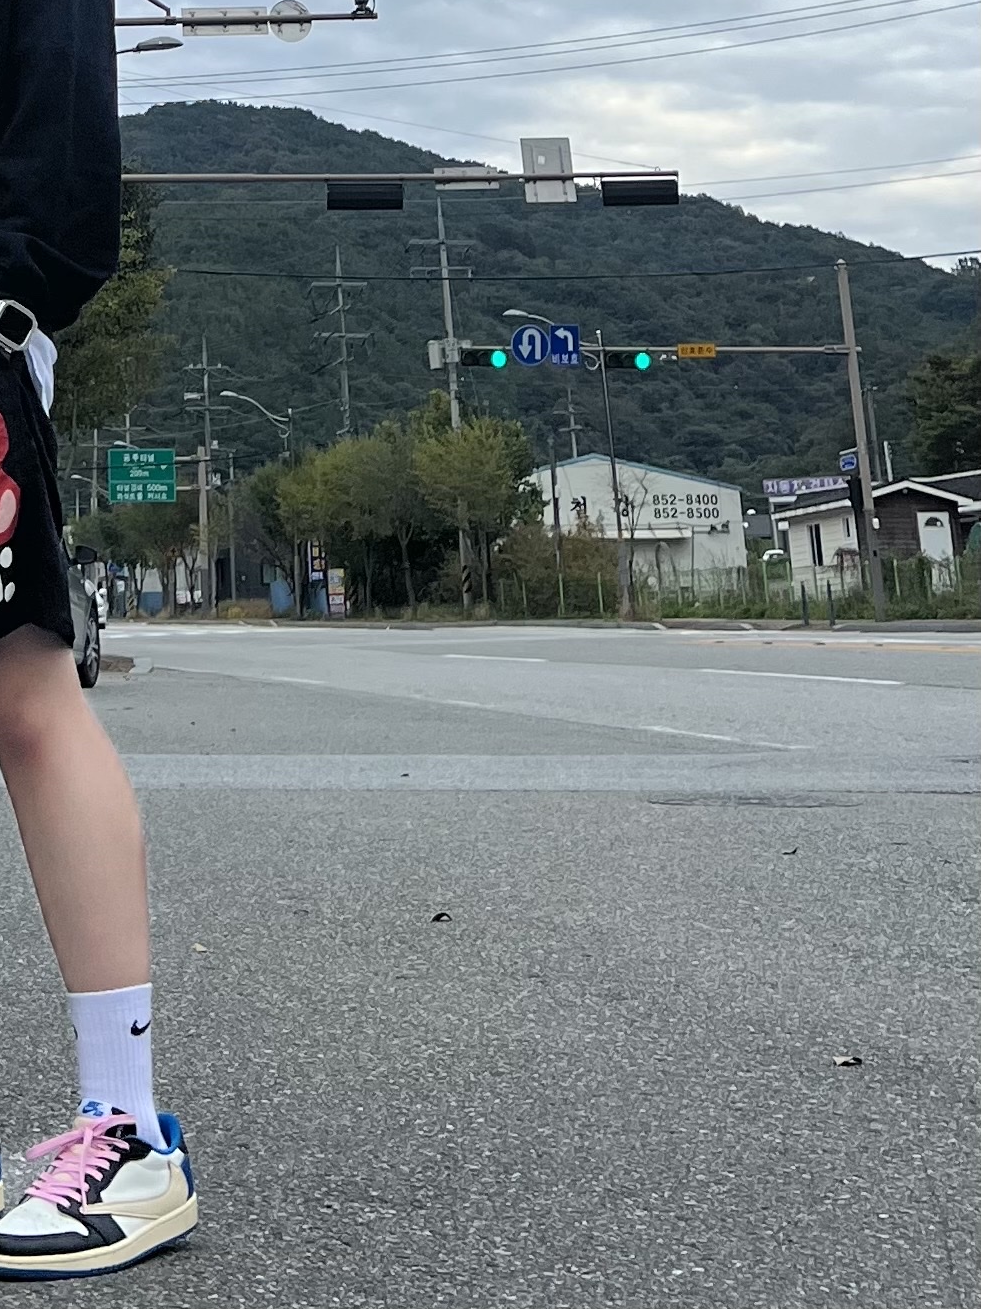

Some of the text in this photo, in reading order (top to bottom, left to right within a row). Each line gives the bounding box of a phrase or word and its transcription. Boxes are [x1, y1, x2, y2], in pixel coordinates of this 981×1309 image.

[551, 353, 580, 365] 비보호
[652, 494, 718, 506] 852-8400
[653, 507, 720, 519] 852-8500
